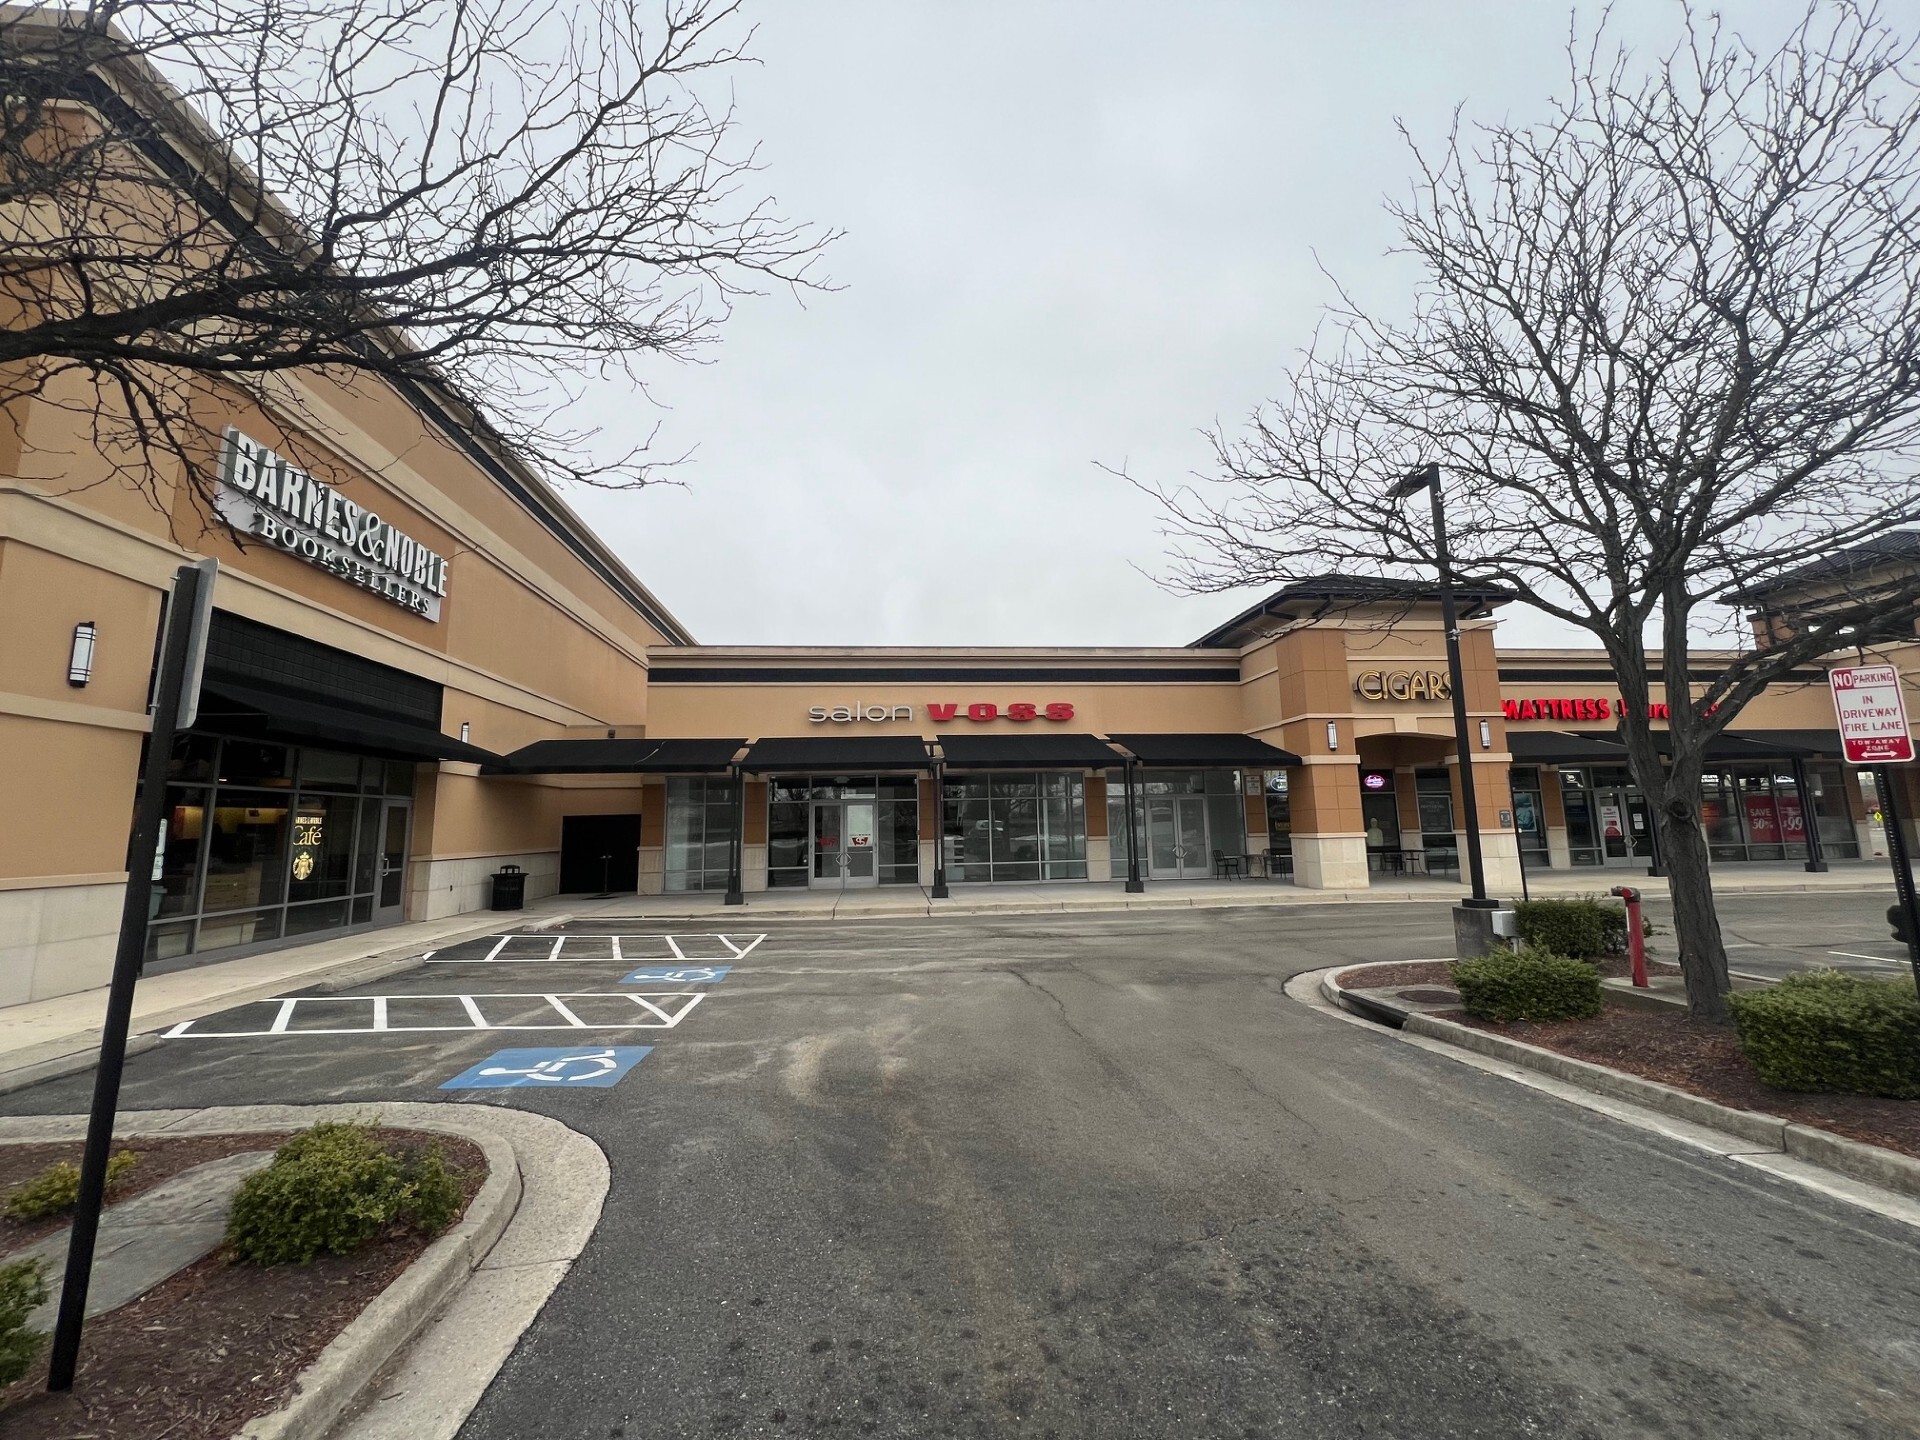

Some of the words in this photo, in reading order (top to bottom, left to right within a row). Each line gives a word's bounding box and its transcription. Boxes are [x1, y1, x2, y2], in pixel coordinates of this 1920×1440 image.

[259, 512, 430, 614] BOOKSELLERS
[1833, 673, 1852, 687] NO
[1853, 672, 1893, 683] PARKING
[1862, 695, 1873, 704] IN
[808, 700, 913, 723] salon
[1500, 699, 1610, 720] MATTRESS
[1843, 707, 1897, 719] DRIVEWAY
[1844, 723, 1869, 732] FIRE
[1872, 721, 1903, 731] LANE
[1750, 808, 1772, 817] SAVE
